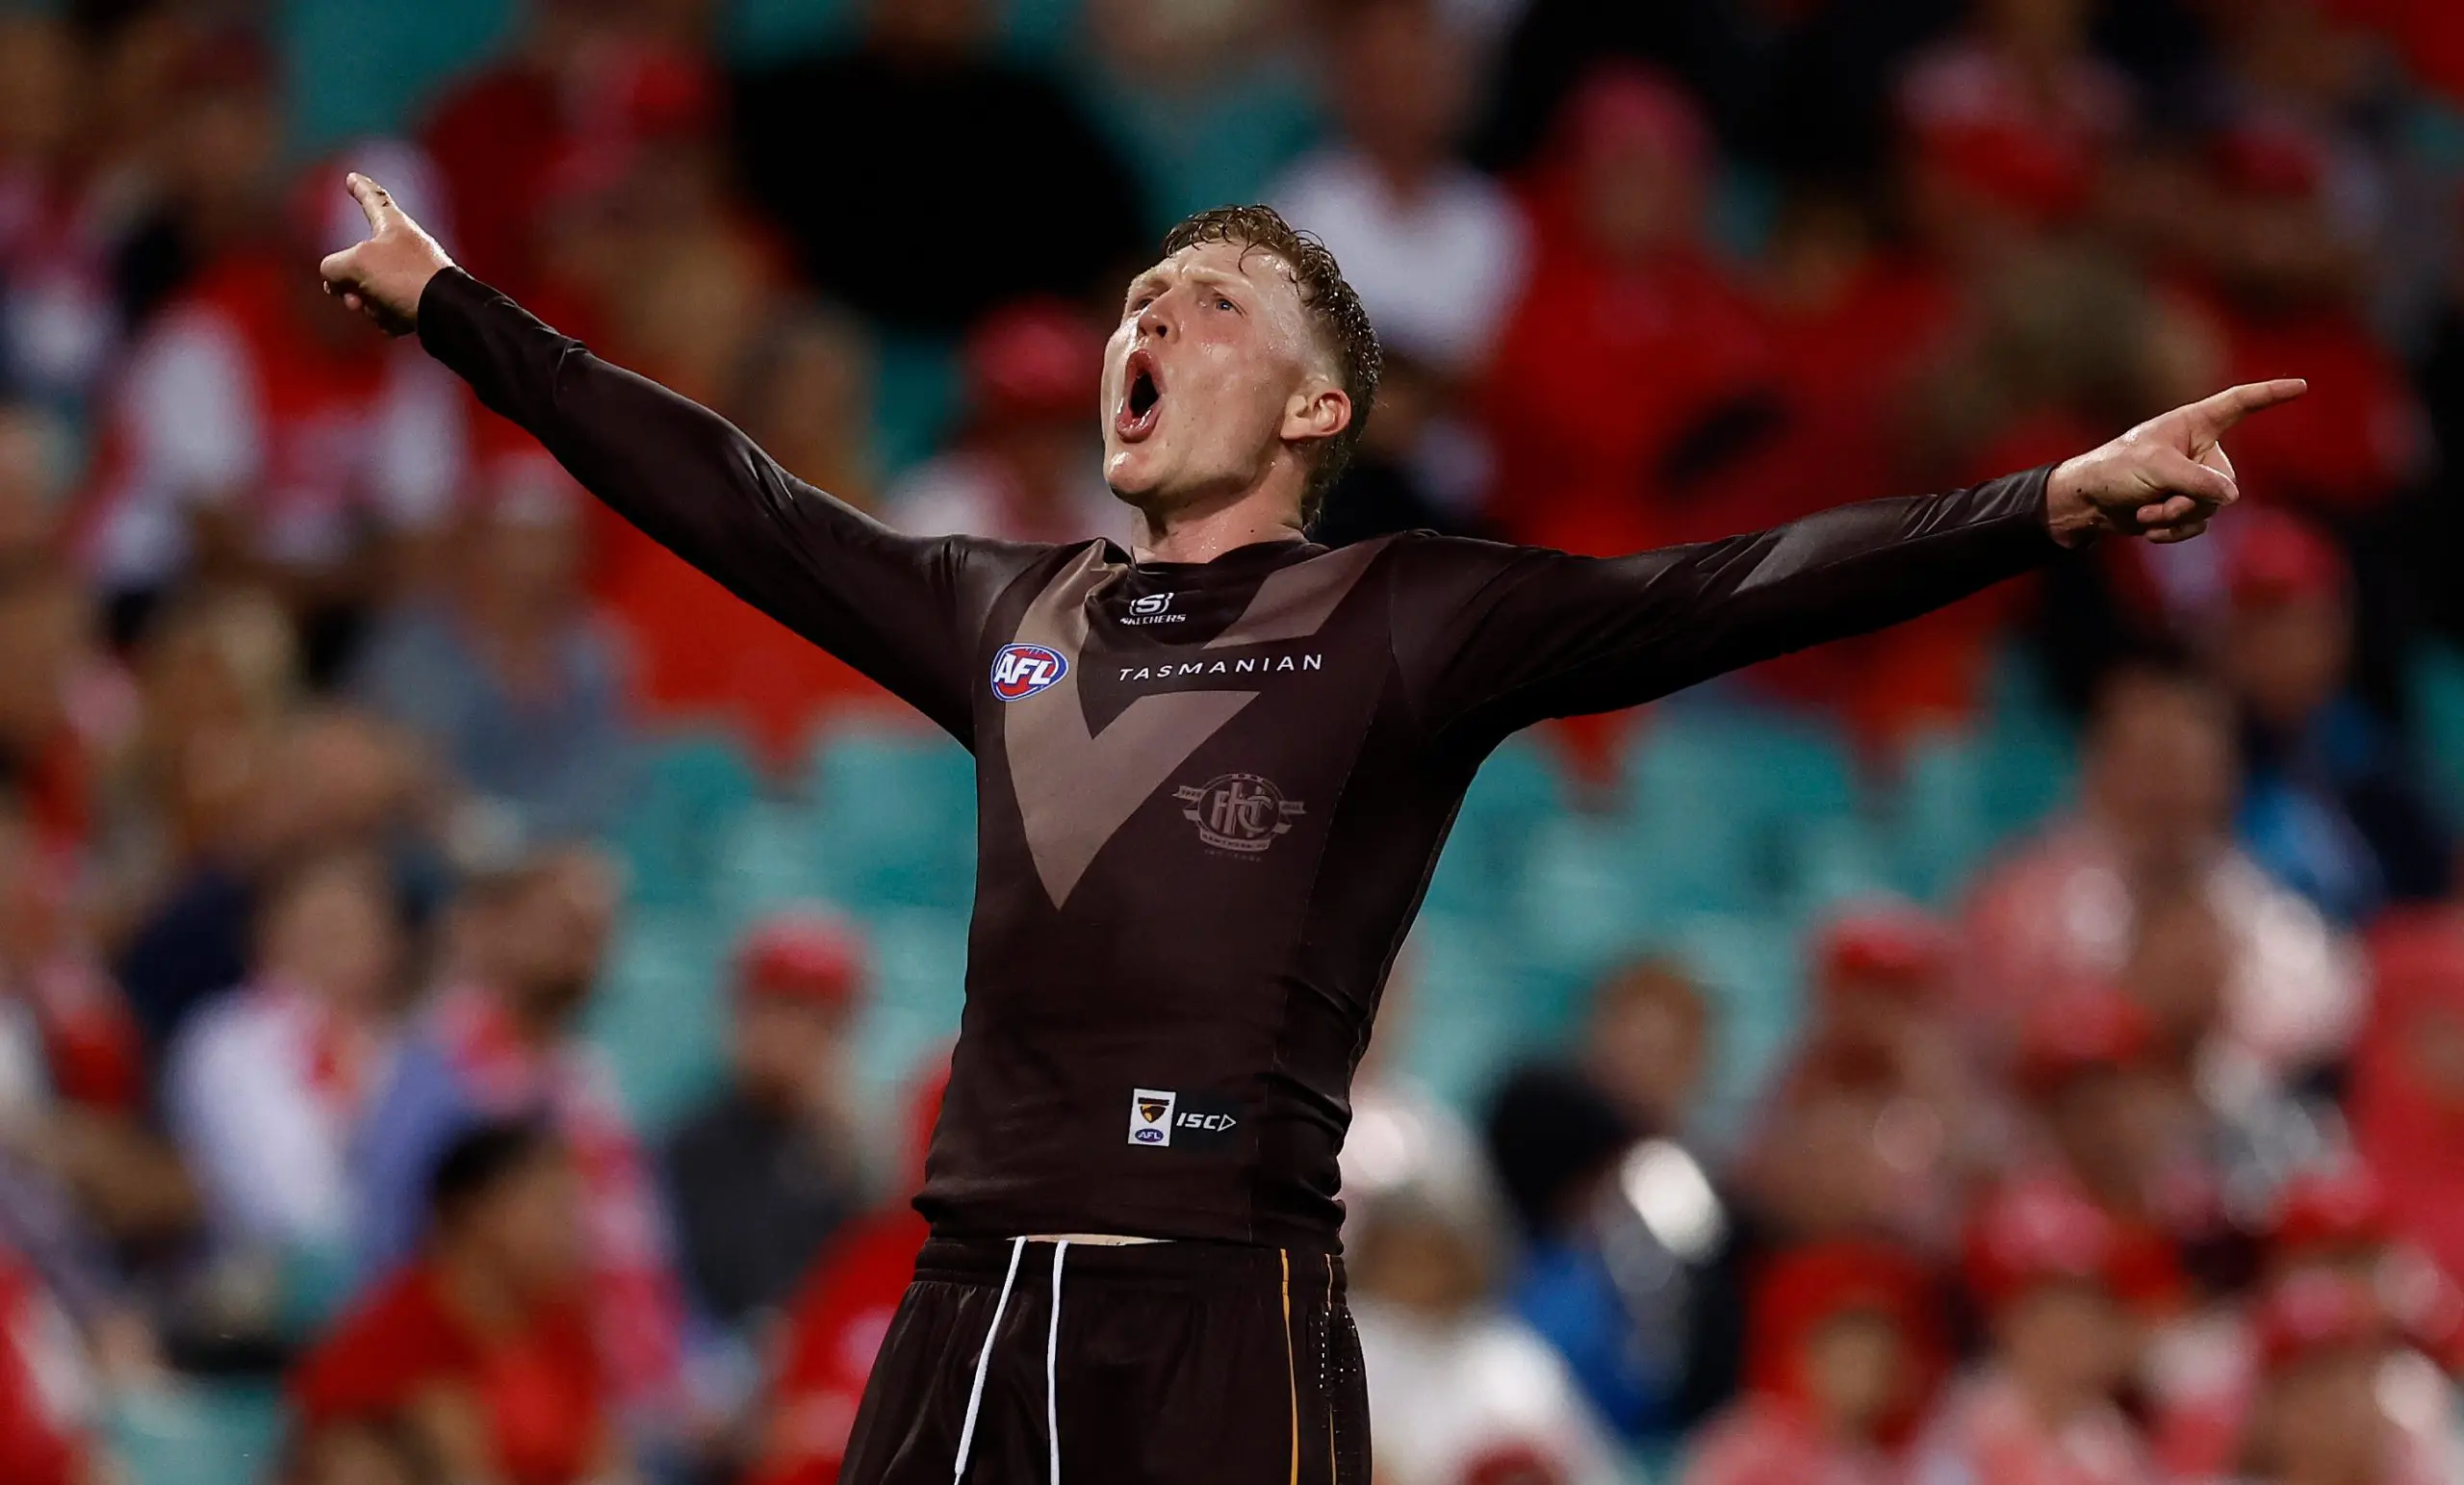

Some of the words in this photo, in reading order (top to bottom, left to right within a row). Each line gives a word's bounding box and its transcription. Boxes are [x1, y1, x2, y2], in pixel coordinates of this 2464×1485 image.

[993, 653, 1053, 684] AFL
[1119, 653, 1322, 681] TASMANIAN
[1176, 1113, 1219, 1130] ISC
[1138, 1131, 1161, 1139] AFL
